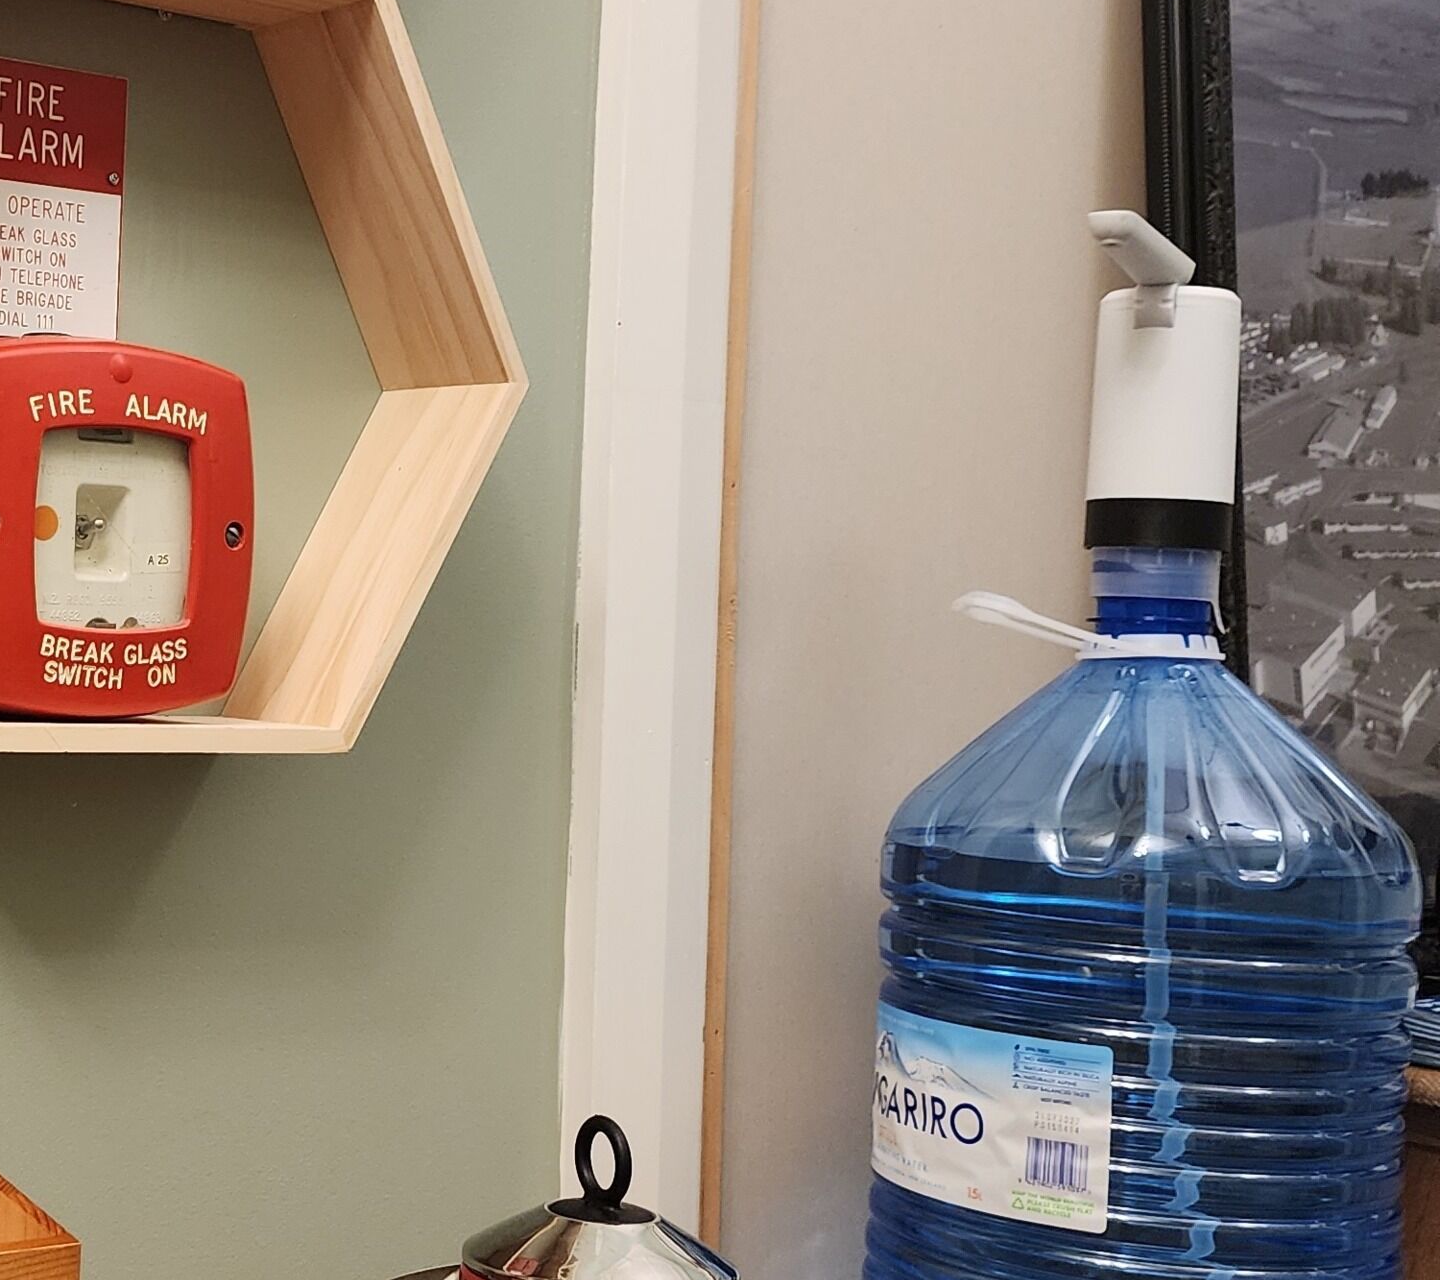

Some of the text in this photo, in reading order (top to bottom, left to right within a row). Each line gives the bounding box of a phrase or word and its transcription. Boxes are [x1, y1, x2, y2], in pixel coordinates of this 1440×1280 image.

[8, 195, 85, 223] OPERATE
[33, 229, 77, 248] GLASS
[50, 252, 66, 268] ON
[10, 268, 85, 291] TELEPHONE
[16, 290, 73, 310] BRIGADE
[37, 314, 54, 329] 111
[29, 388, 208, 436] FIRE ALARM
[147, 555, 155, 566] A
[40, 634, 188, 665] BREAK GLASS
[43, 660, 176, 690] SWITCH ON
